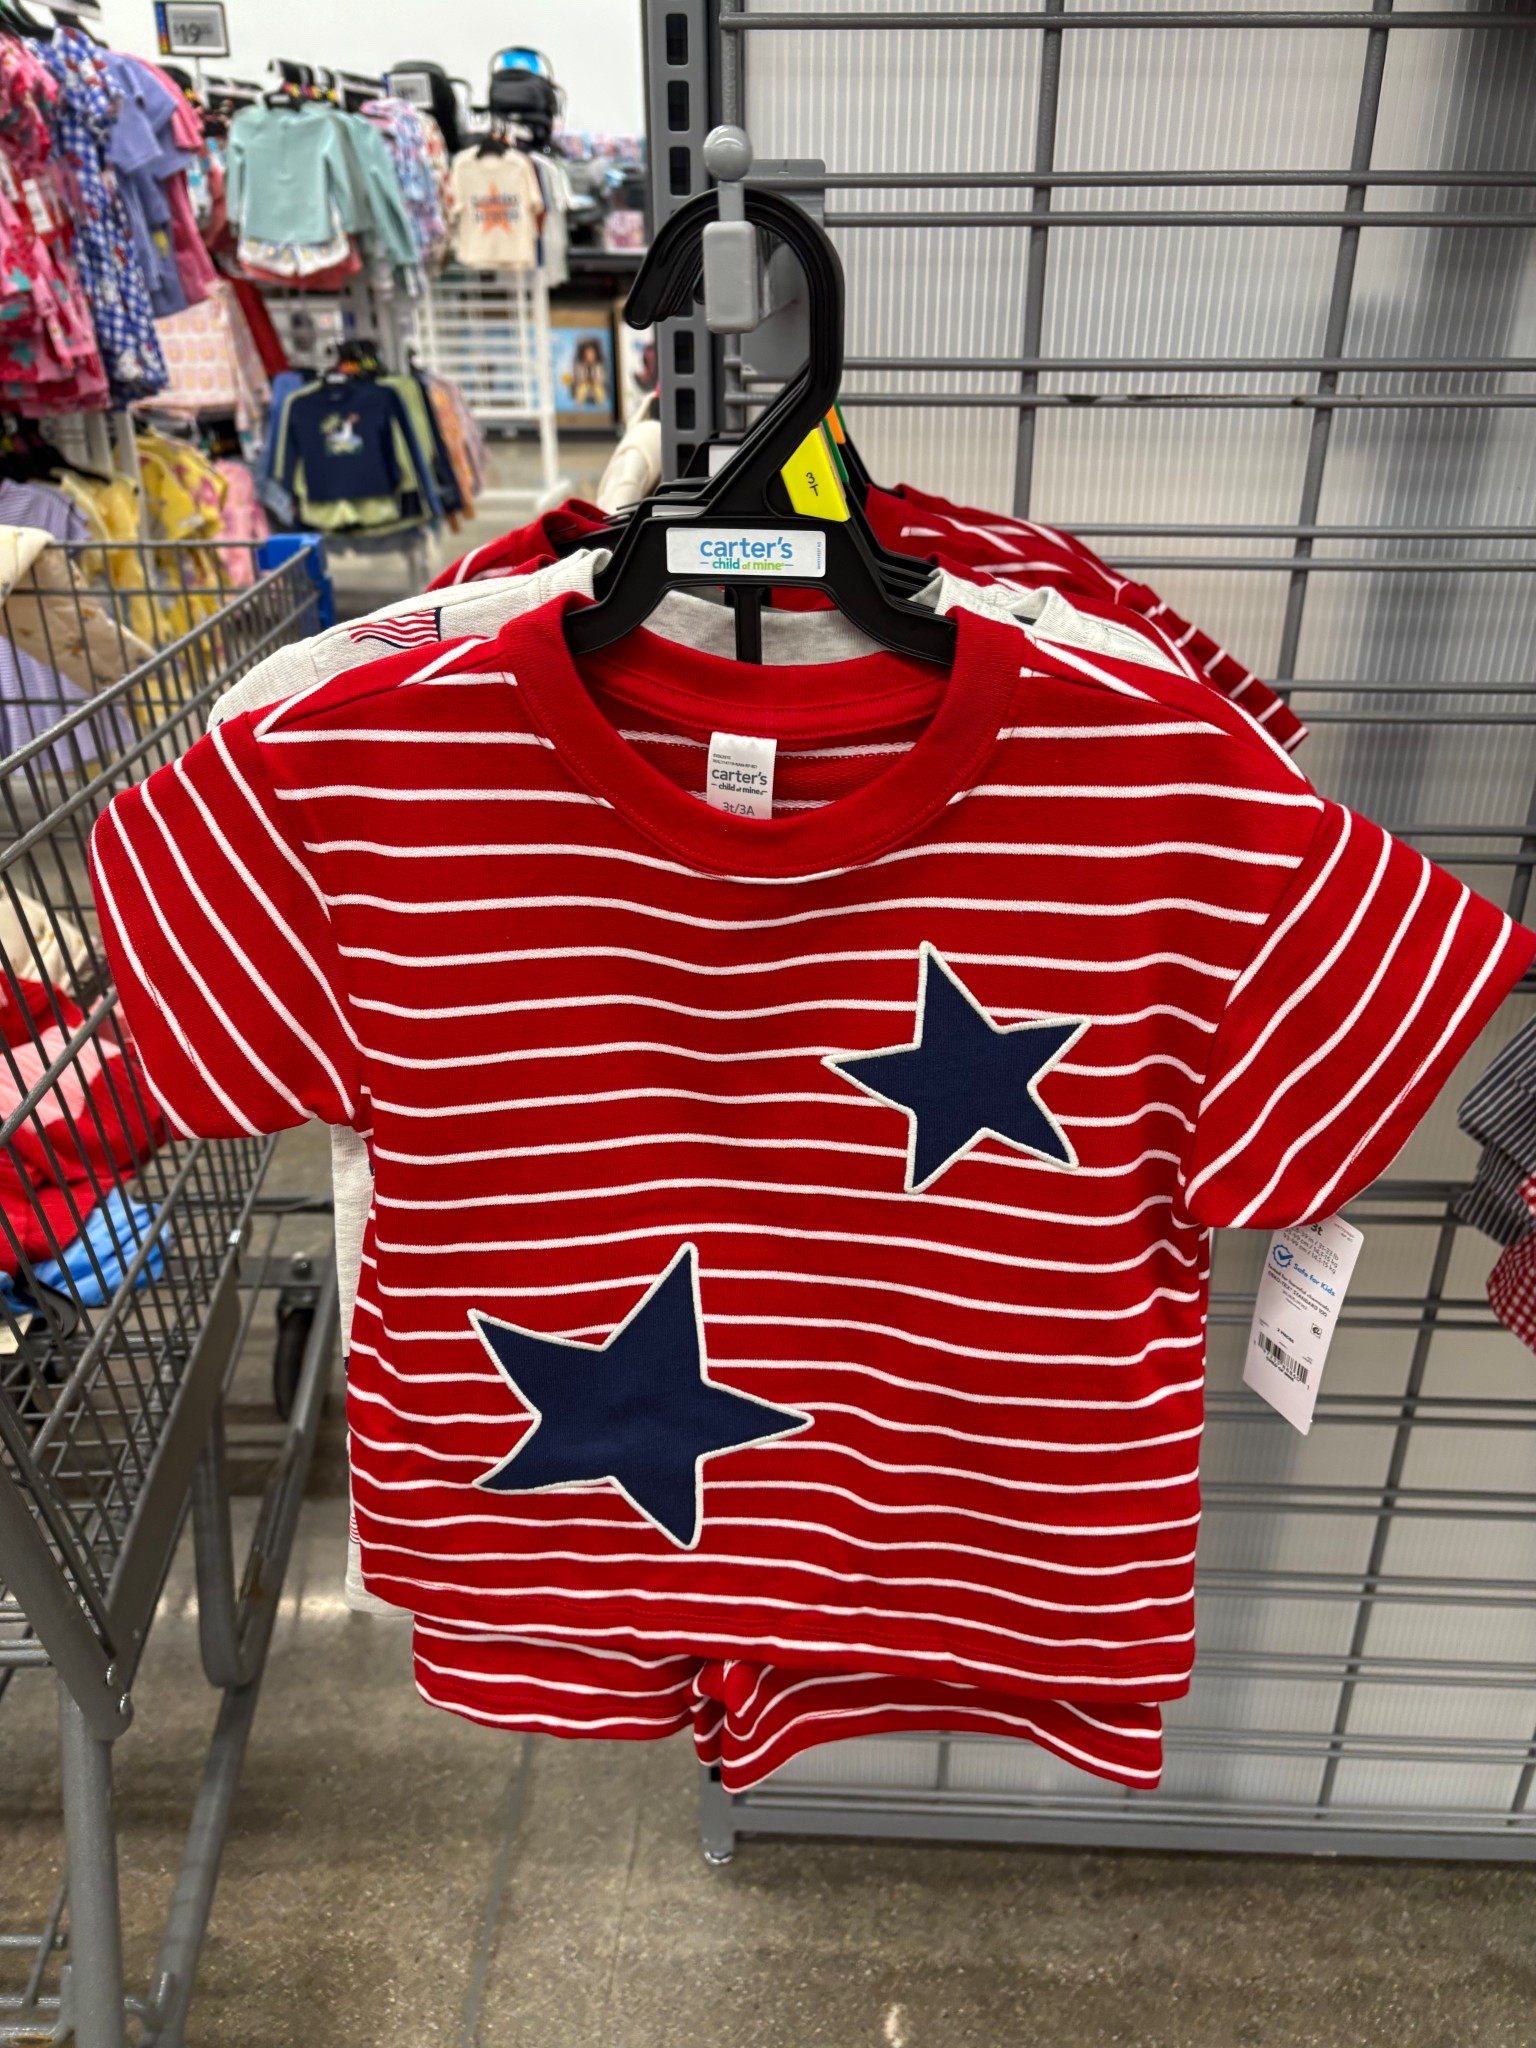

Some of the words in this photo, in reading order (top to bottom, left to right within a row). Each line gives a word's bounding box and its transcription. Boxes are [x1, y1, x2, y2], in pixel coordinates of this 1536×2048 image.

[700, 537, 793, 559] carter's
[712, 557, 740, 570] child
[742, 561, 751, 570] of
[711, 768, 768, 786] carter's
[718, 782, 735, 791] child
[742, 786, 760, 795] mine
[722, 801, 755, 816] 3t/3A
[1310, 1223, 1323, 1236] 3t
[1293, 1263, 1309, 1278] Safe
[1309, 1274, 1320, 1285] for
[1320, 1281, 1336, 1297] Kids
[1292, 1290, 1319, 1311] STANDARD
